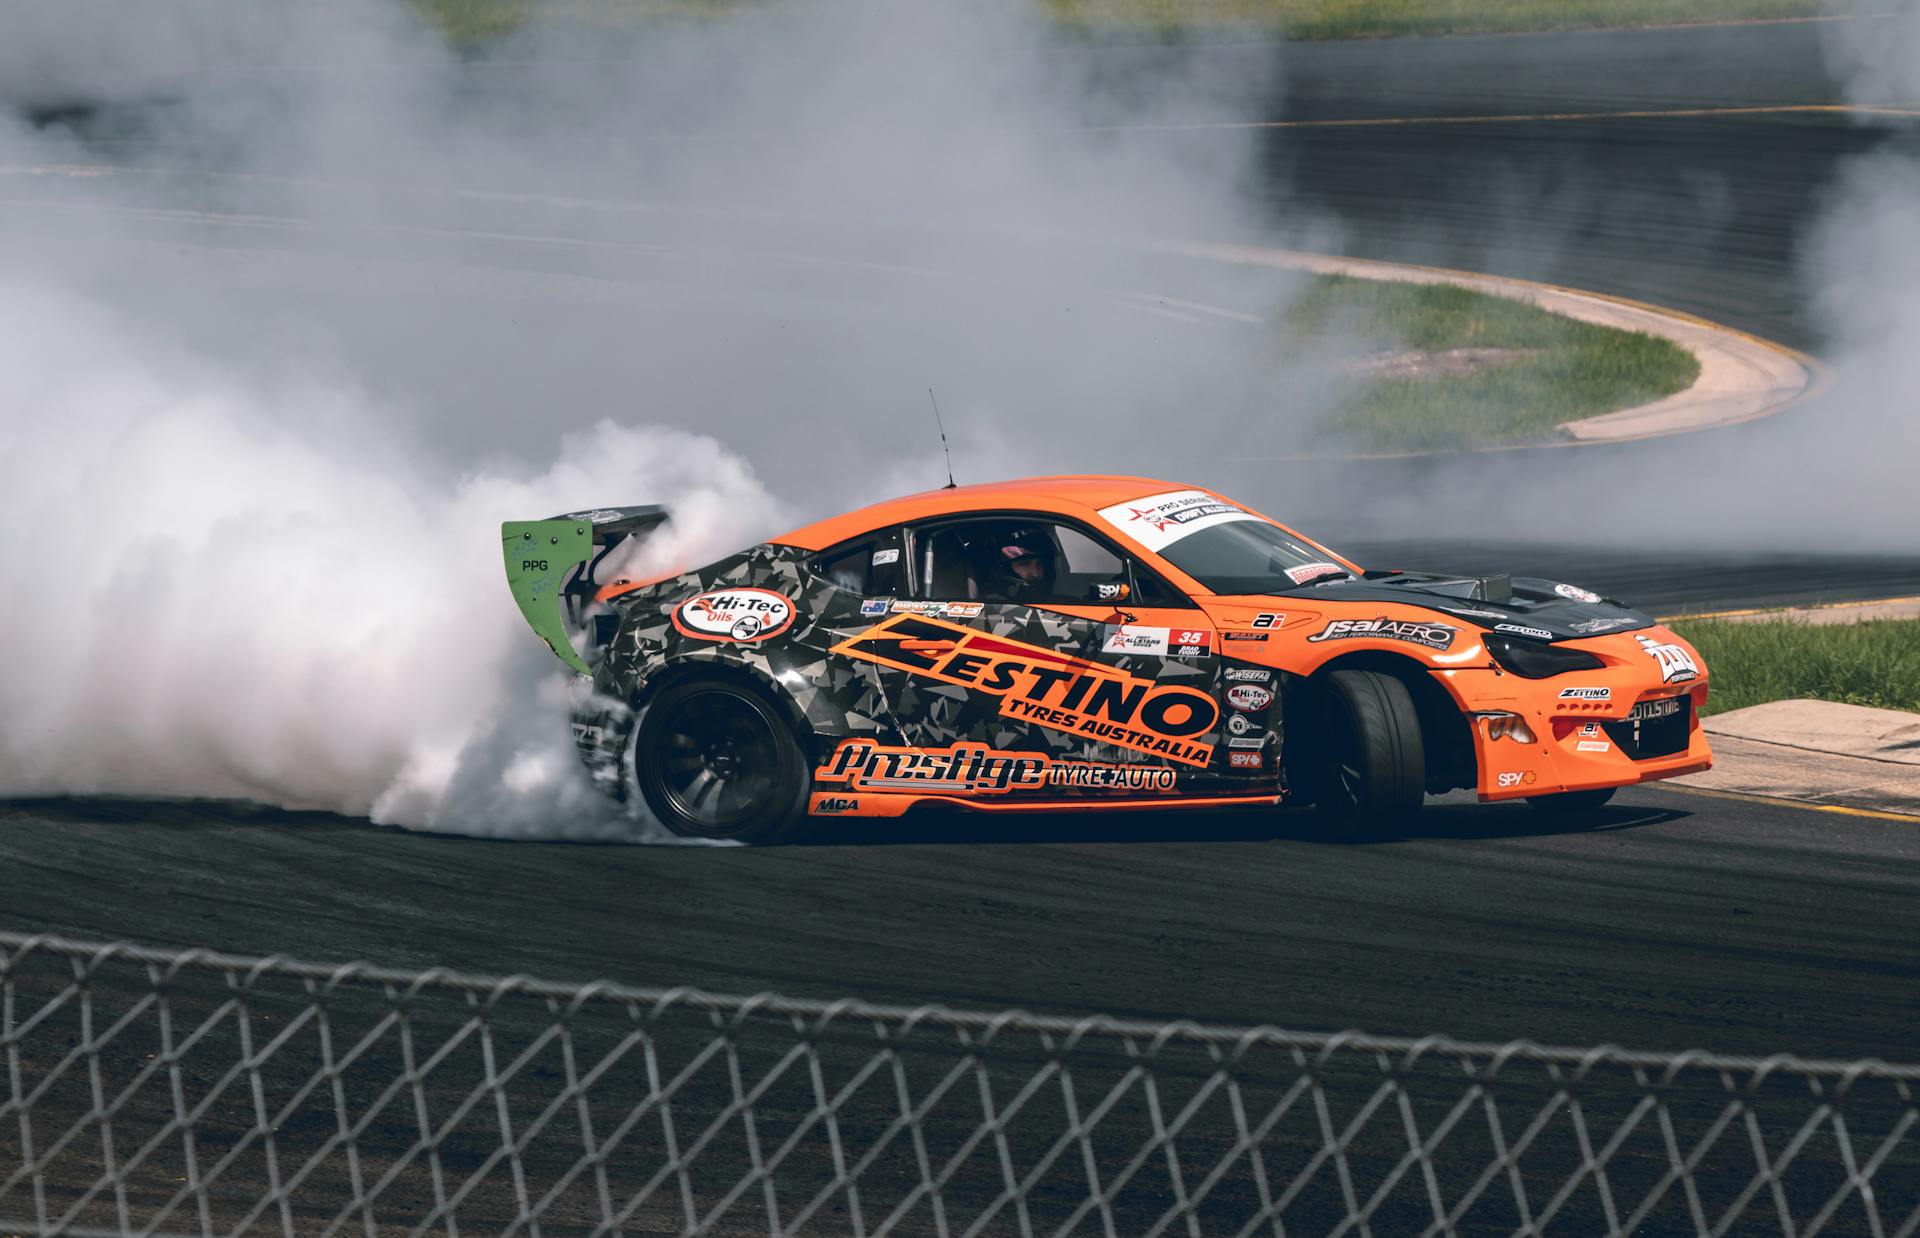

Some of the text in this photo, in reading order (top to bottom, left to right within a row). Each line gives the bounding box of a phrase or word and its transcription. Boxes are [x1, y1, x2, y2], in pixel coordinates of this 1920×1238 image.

[1157, 501, 1178, 513] PRO
[523, 560, 548, 571] PPG
[714, 596, 784, 614] Hi-Tec
[1125, 637, 1161, 645] ALLSTARS
[1178, 632, 1203, 645] 35
[1349, 632, 1402, 640] PERFORMANCE
[1402, 635, 1448, 651] COMPOSITES
[848, 618, 1215, 737] ZESTINO
[1240, 689, 1267, 698] Hi-Tec
[1010, 700, 1209, 764] TYRES AUSTRALIA
[820, 745, 1043, 790] Prestige
